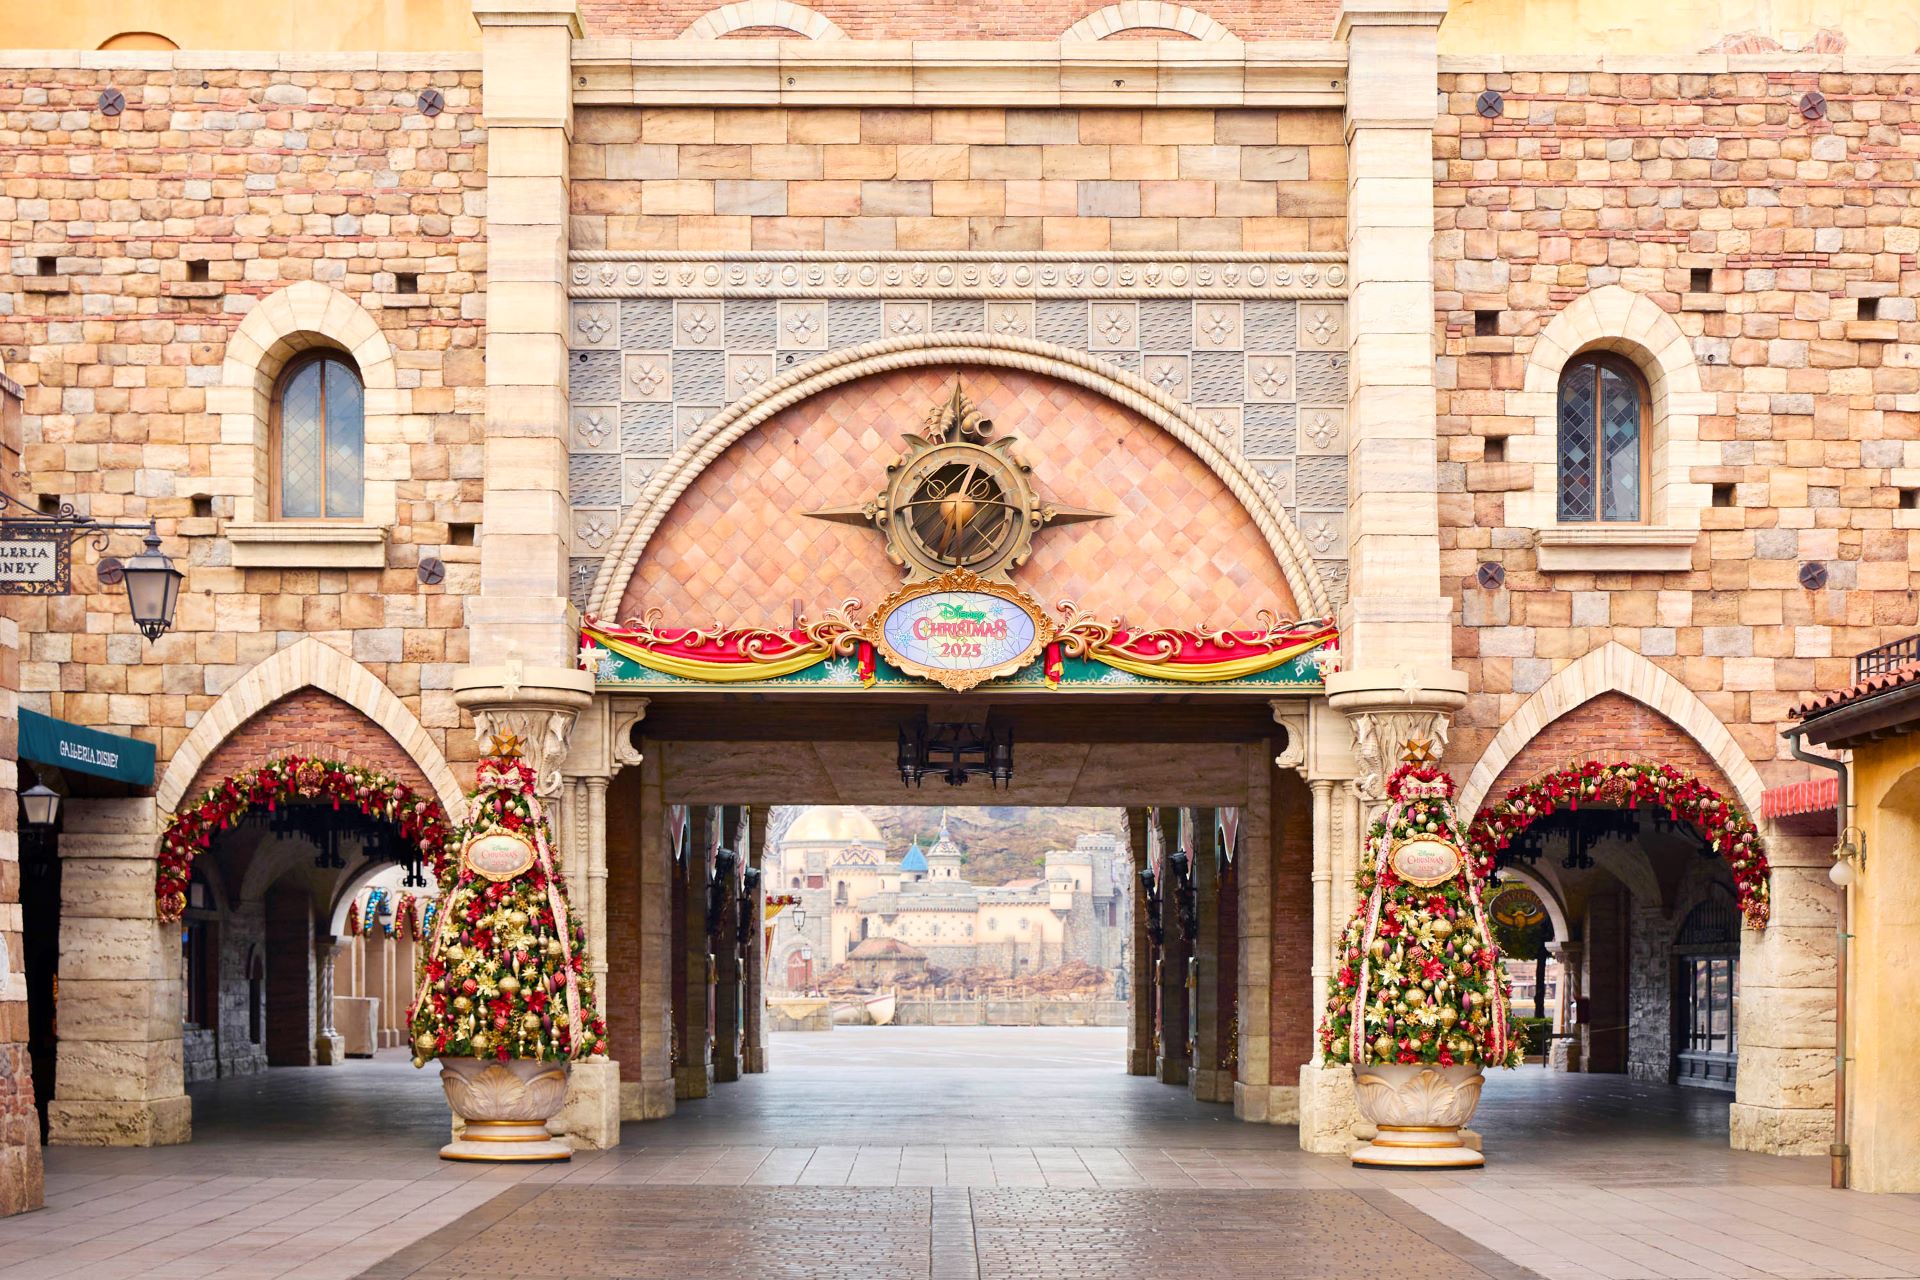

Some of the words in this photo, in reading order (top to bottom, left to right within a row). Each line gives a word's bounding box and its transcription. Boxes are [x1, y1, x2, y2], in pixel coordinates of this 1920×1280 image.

[0, 562, 39, 574] NEY
[913, 616, 1008, 640] CHRISTMAS
[939, 642, 982, 658] 2025
[59, 740, 96, 764] GALLERIA
[96, 749, 119, 769] DISNEY
